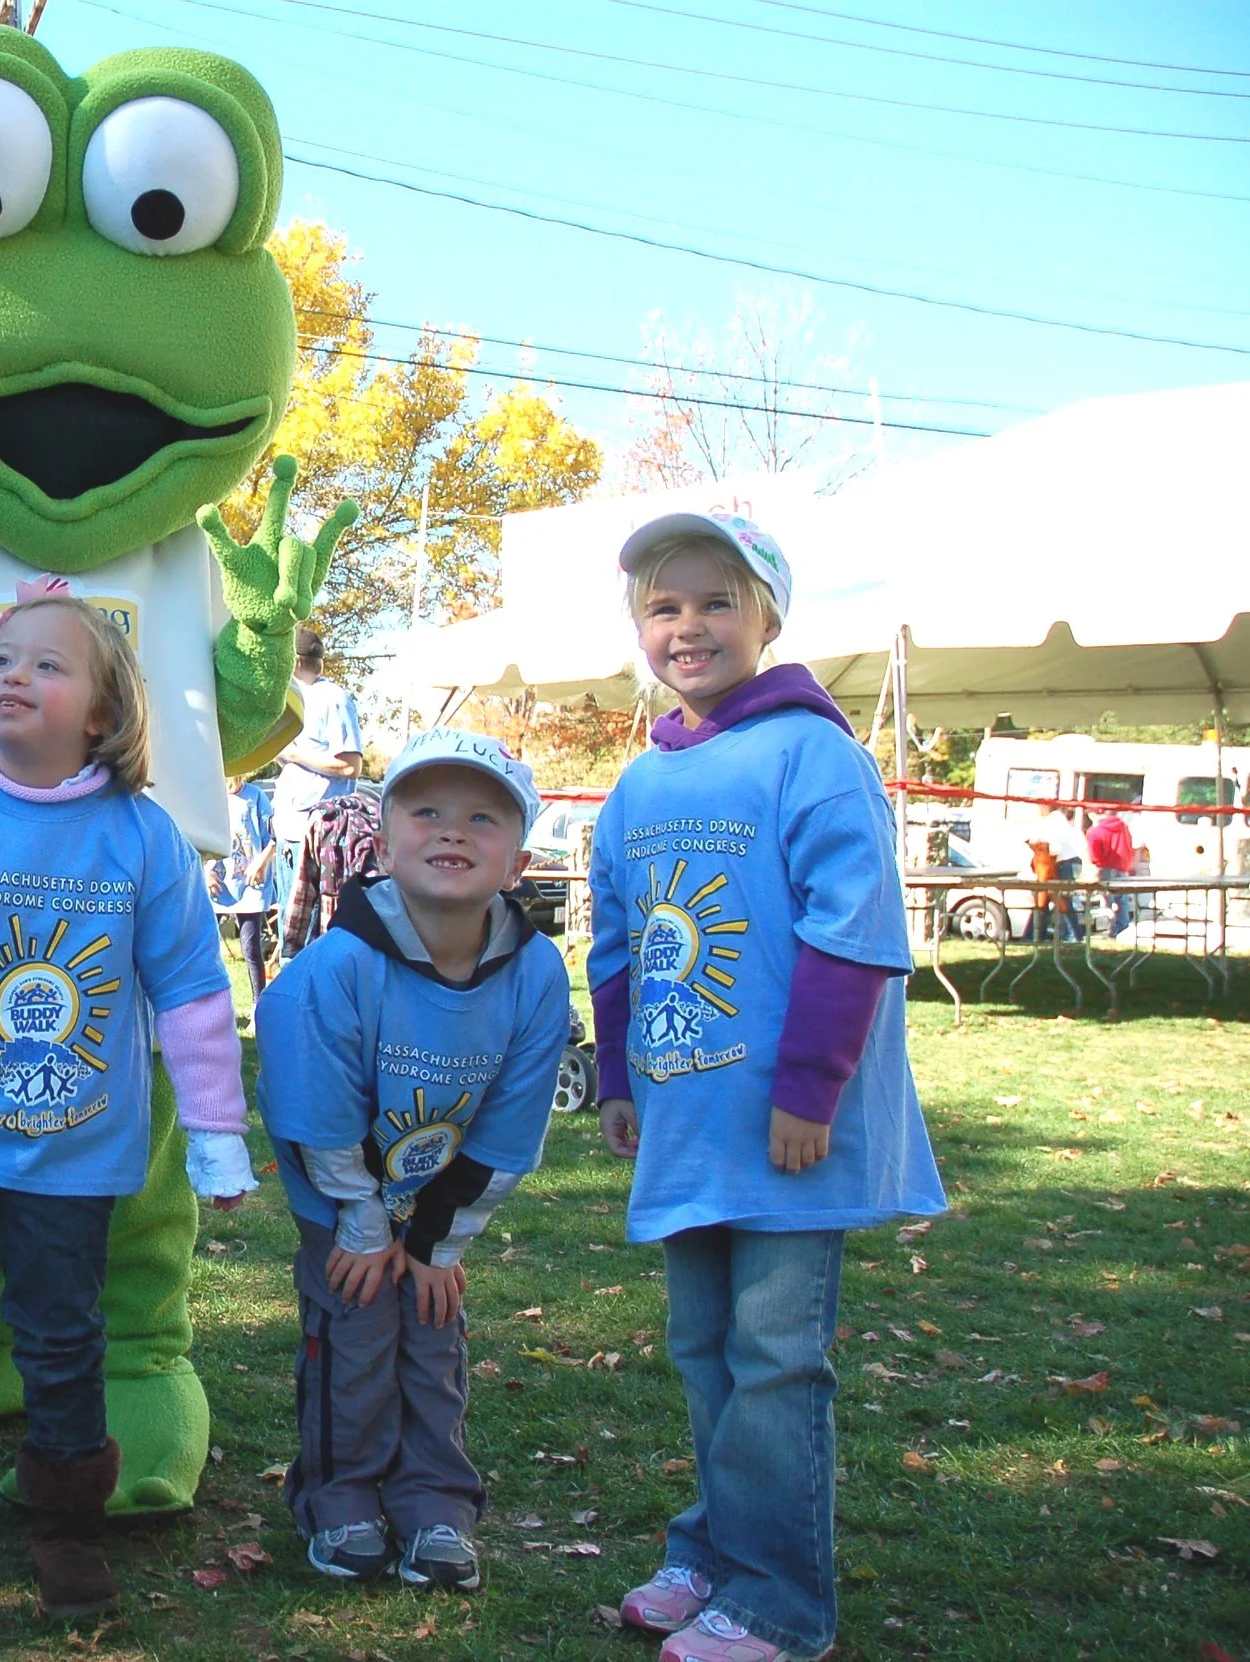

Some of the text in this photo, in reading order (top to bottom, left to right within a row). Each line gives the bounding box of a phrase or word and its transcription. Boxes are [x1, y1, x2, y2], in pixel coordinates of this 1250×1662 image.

[624, 819, 756, 844] ASSACHUSETTS DOWN
[625, 838, 748, 861] YNDROME CONGRESS
[89, 879, 136, 895] DOWN
[51, 897, 133, 914] CONGRESS
[10, 1005, 64, 1022] BUDDY
[13, 1019, 57, 1034] WALK
[377, 1055, 498, 1086] YNDROME CONG
[16, 1109, 66, 1138] brighter
